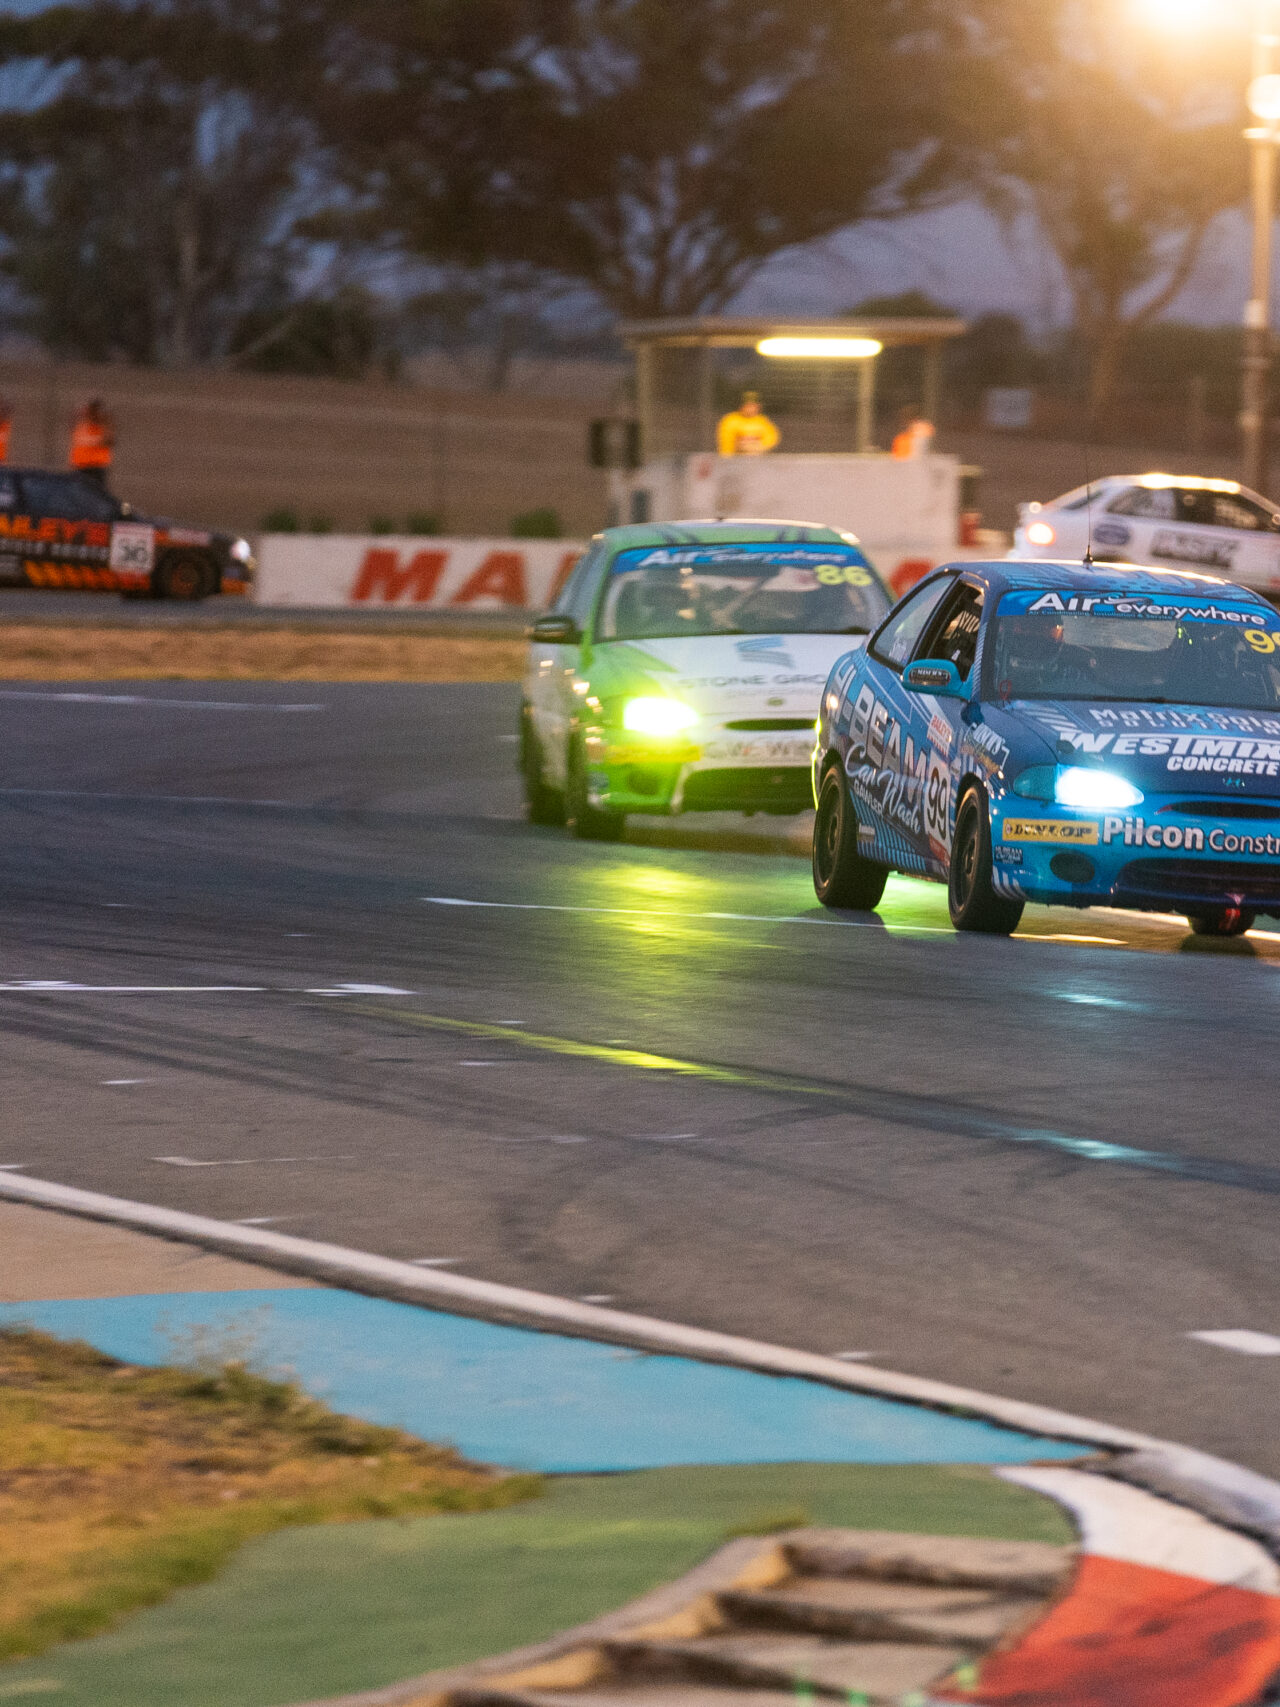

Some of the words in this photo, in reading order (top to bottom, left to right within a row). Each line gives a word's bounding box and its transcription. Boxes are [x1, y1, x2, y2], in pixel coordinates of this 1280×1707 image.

[813, 564, 873, 587] 86
[1029, 593, 1102, 611] Air
[1116, 603, 1267, 626] everywhere
[1167, 757, 1280, 776] CONCRETE
[877, 769, 920, 834] Wash
[927, 767, 948, 841] 99
[1103, 815, 1205, 850] Pilcon
